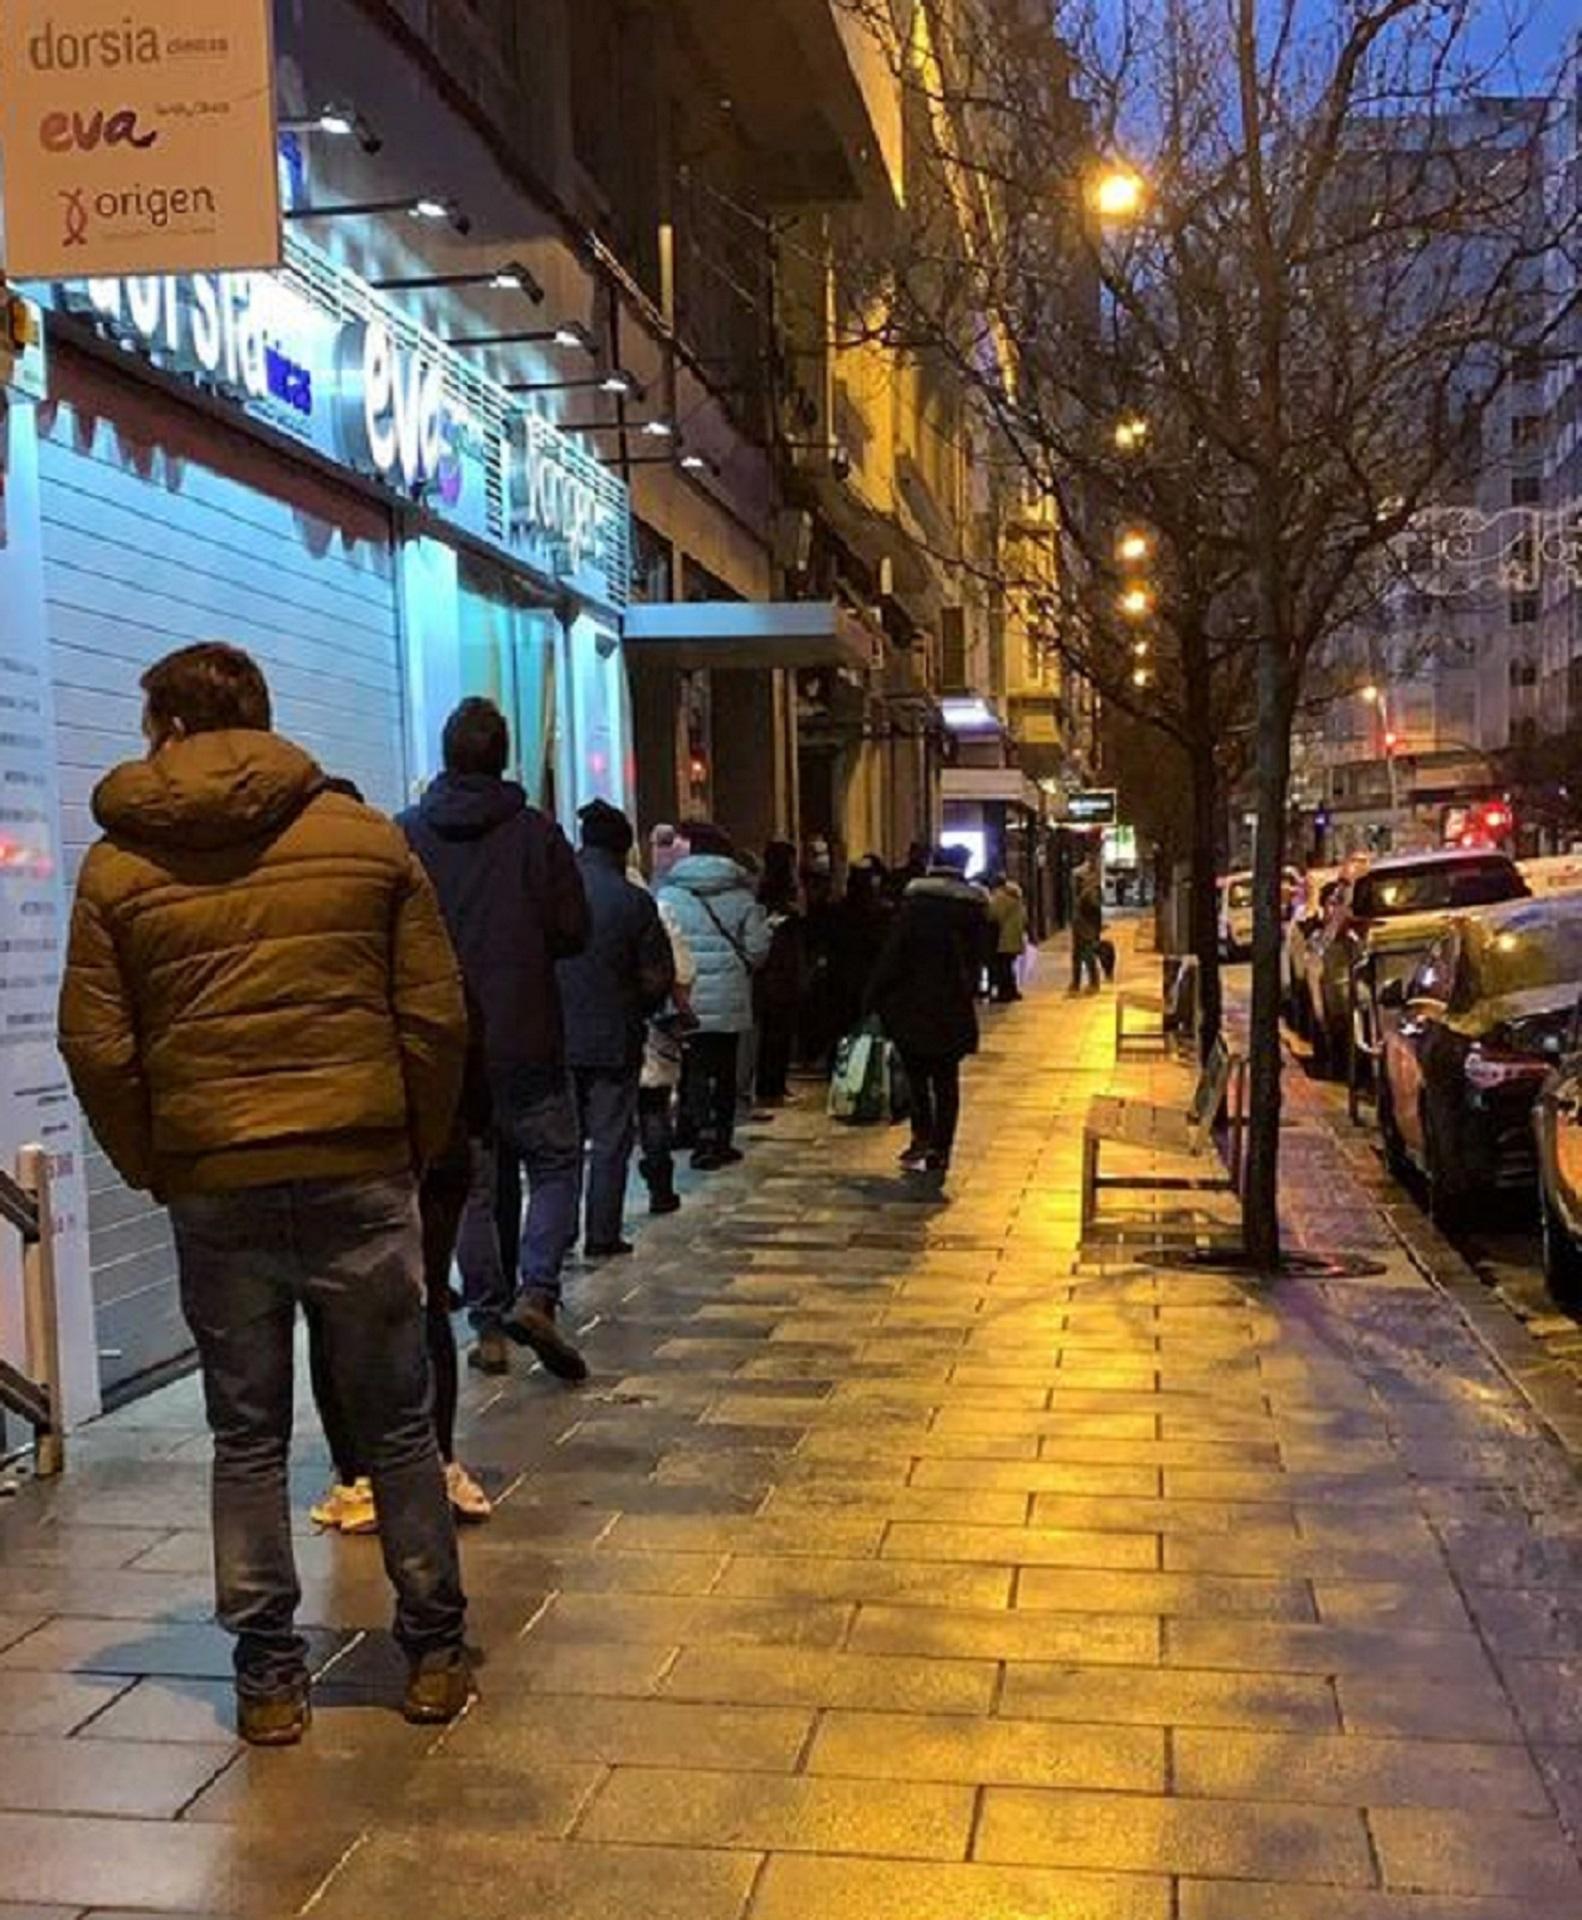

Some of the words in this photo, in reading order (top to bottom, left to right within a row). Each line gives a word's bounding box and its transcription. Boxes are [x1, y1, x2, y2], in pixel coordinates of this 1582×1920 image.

[30, 16, 160, 70] dorsia
[39, 109, 157, 152] eva
[95, 184, 215, 228] origen
